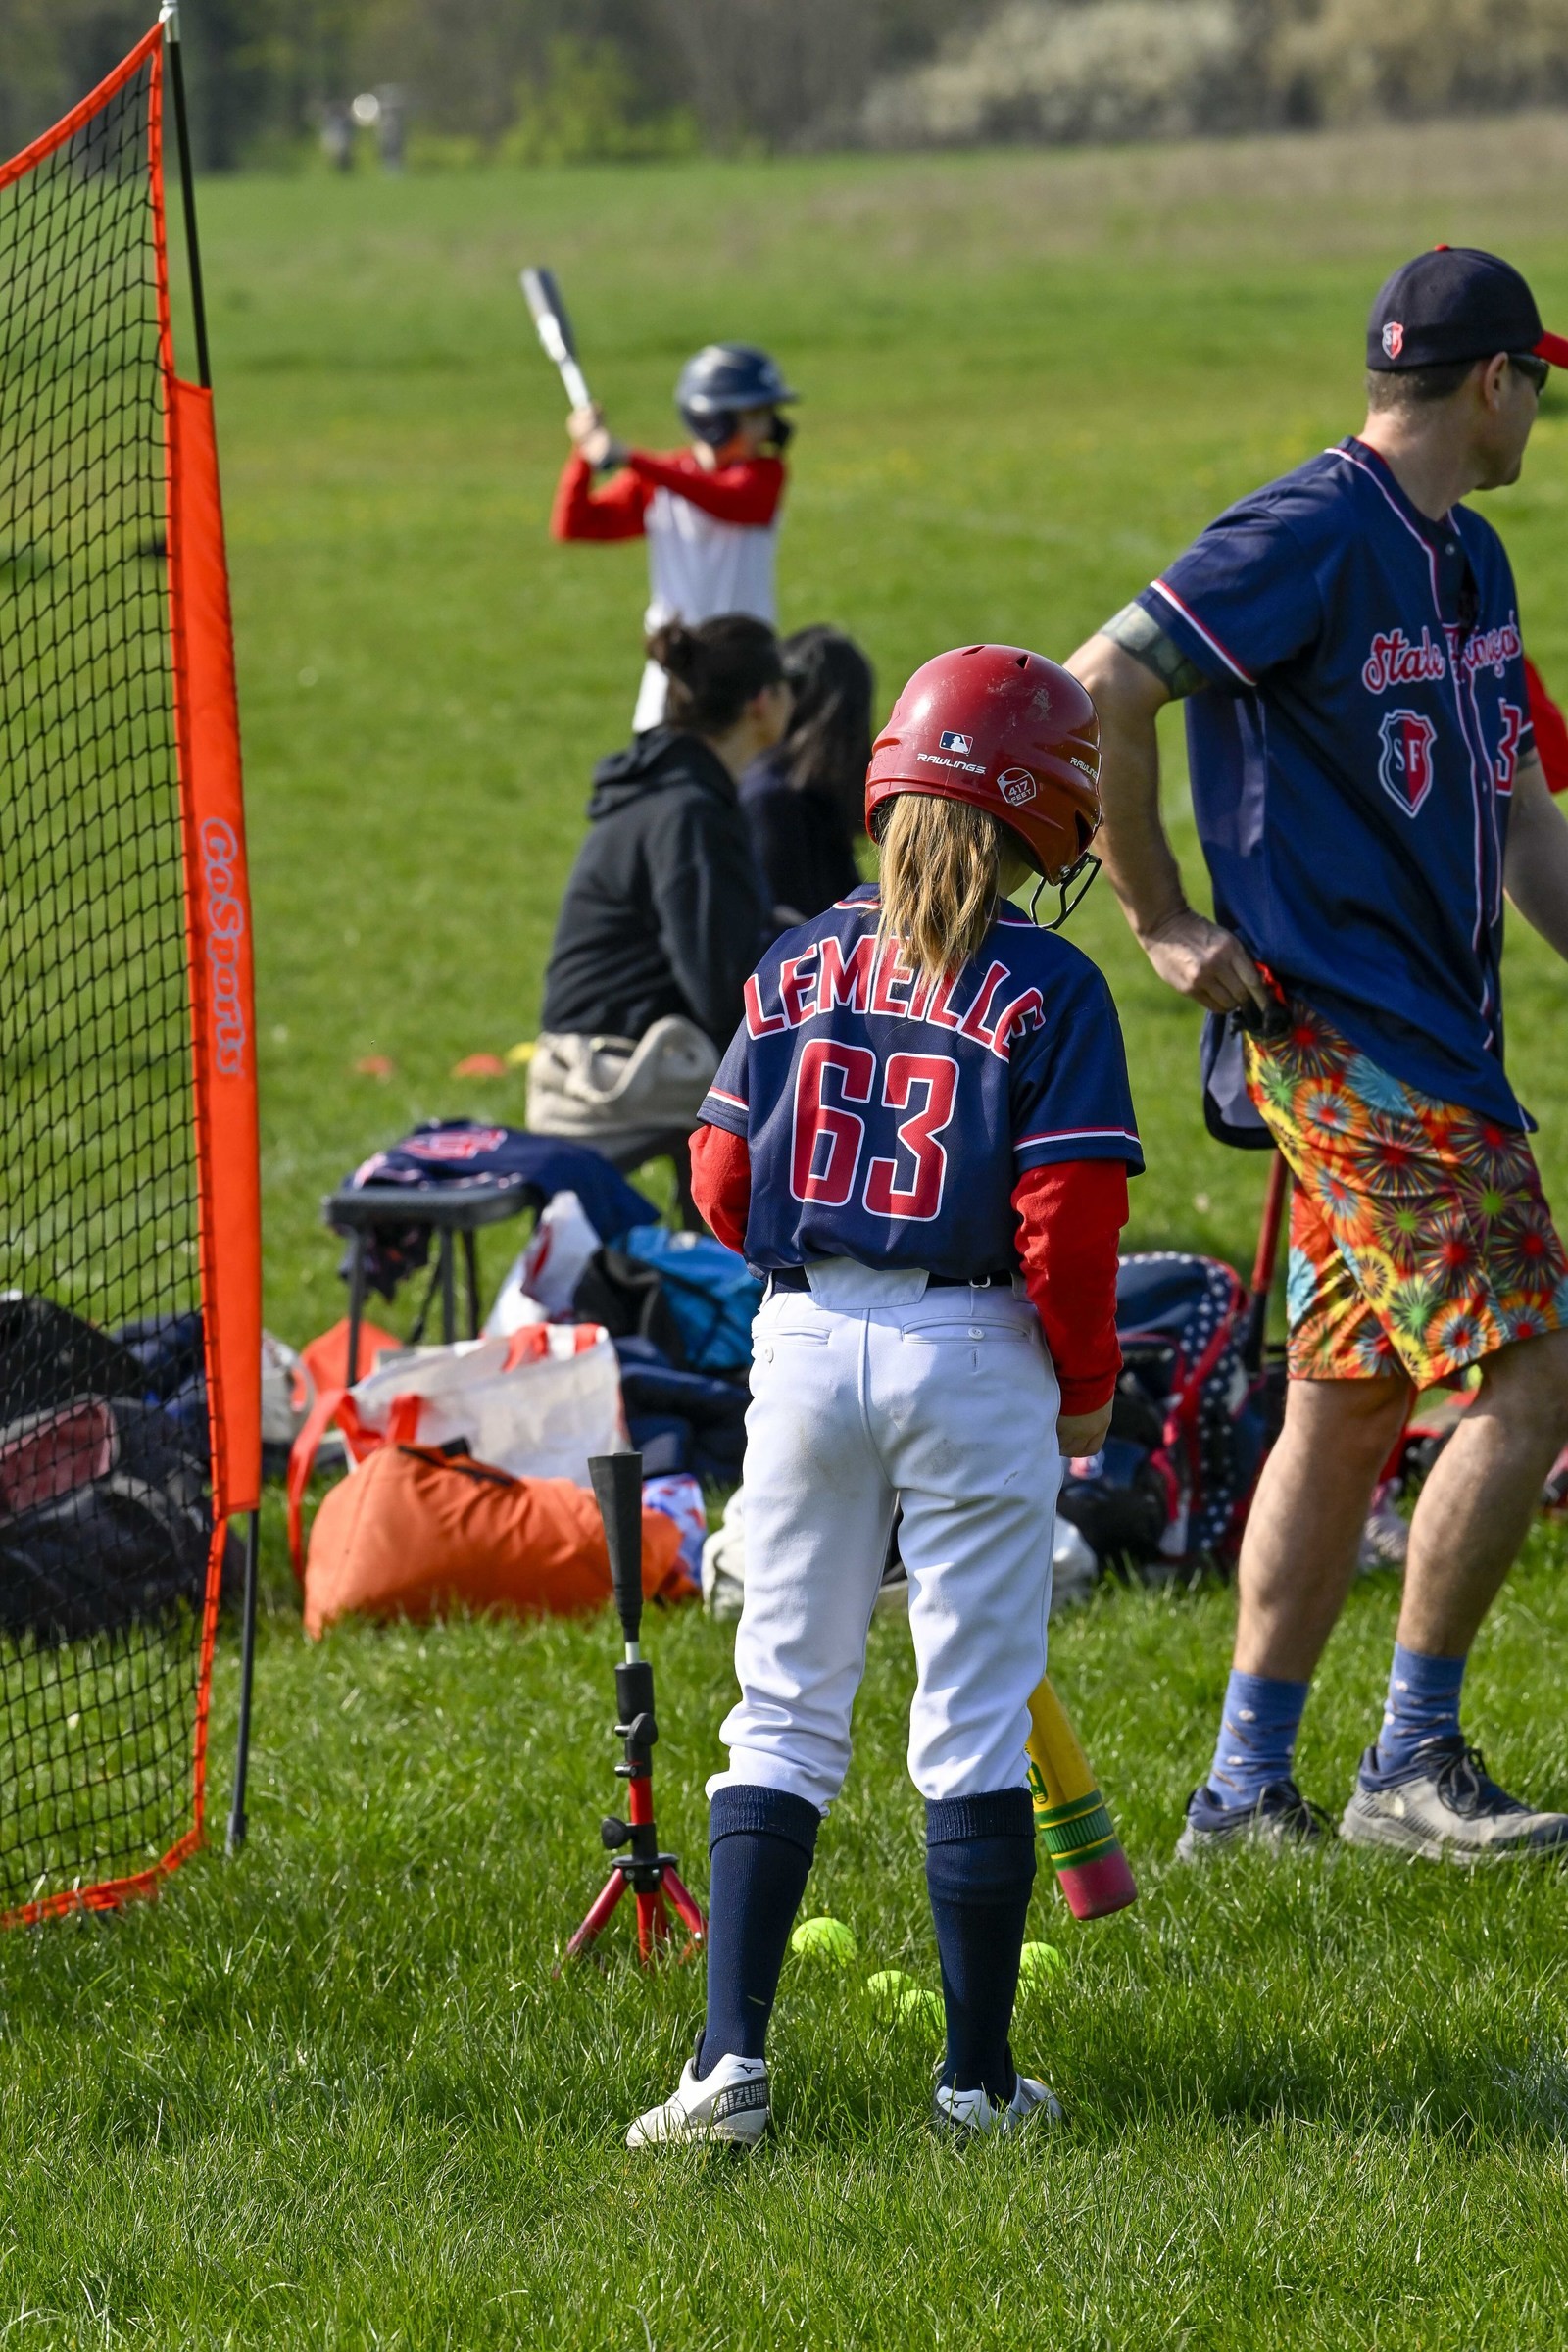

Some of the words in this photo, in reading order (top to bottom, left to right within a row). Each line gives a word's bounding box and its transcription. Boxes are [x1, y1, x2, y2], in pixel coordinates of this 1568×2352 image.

[916, 753, 987, 775] RAWLINGS
[1069, 756, 1099, 780] RAWLING
[1393, 738, 1421, 772] SF
[1008, 780, 1028, 796] 417
[1010, 788, 1032, 804] FEET
[200, 816, 245, 1075] GoSports
[789, 1038, 959, 1222] 63
[710, 2082, 767, 2118] MIZUN
